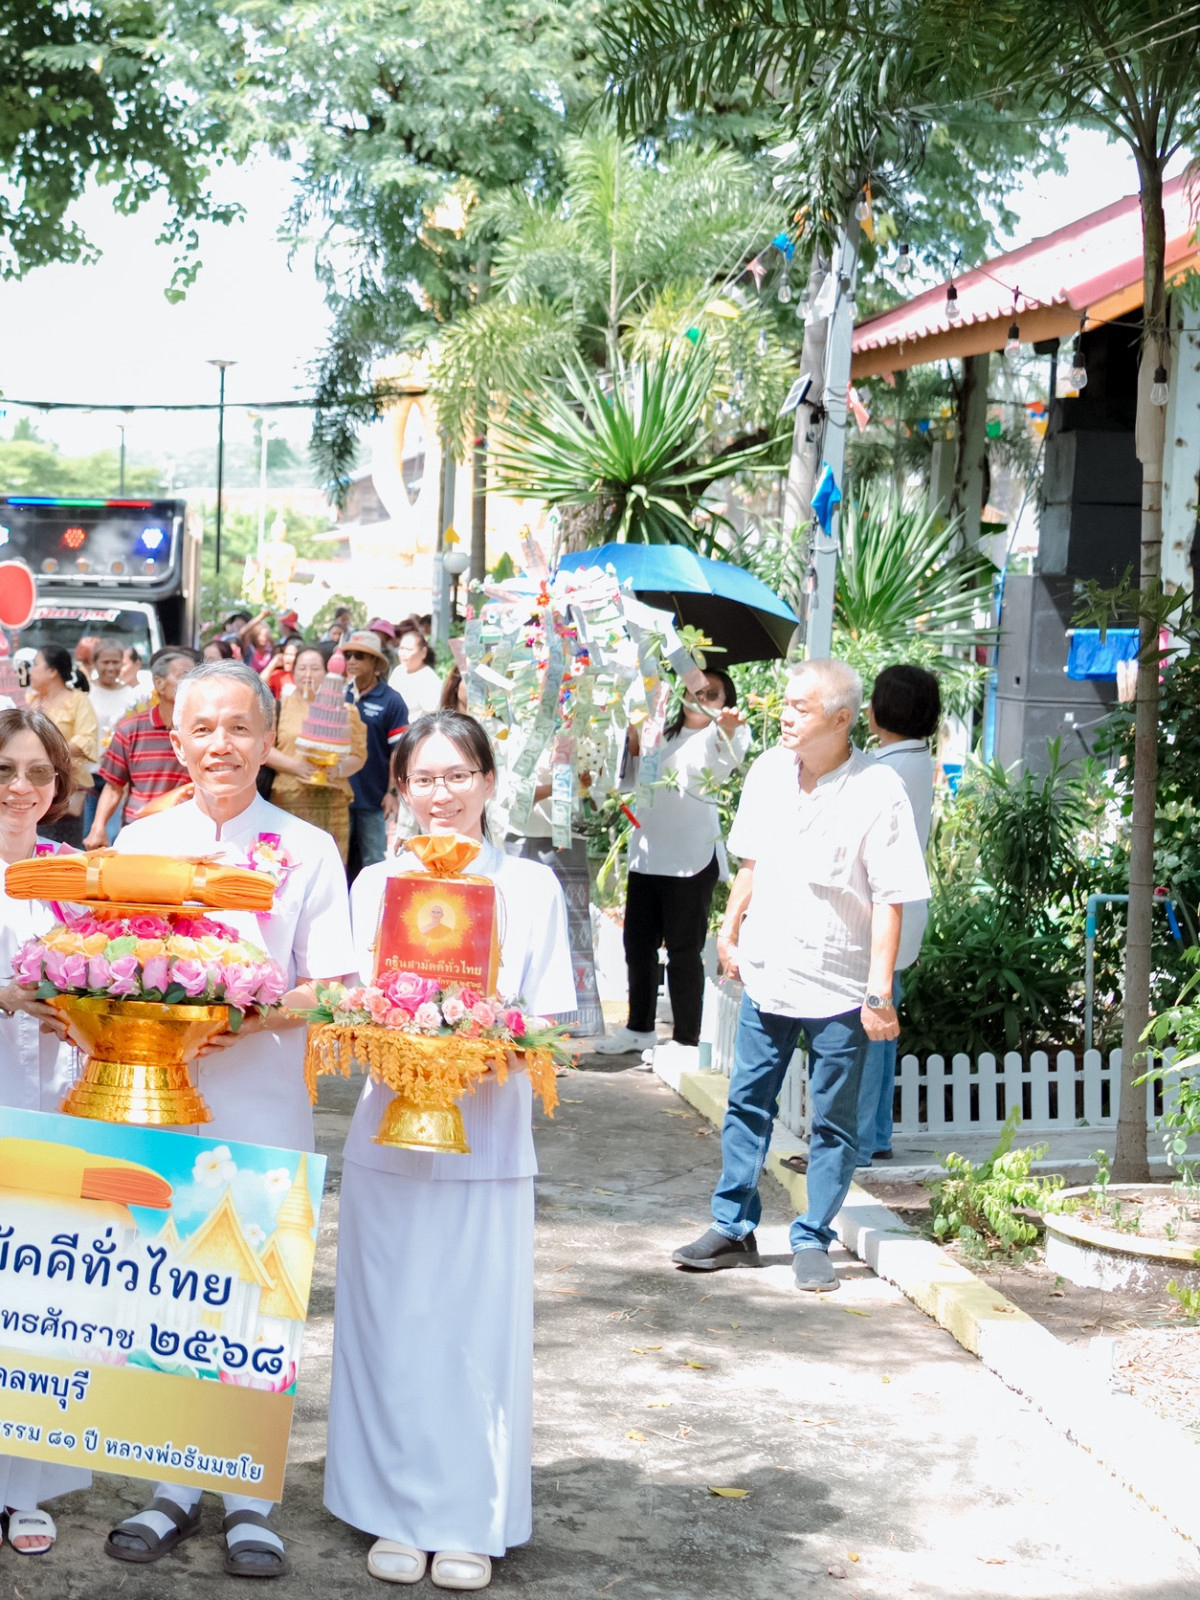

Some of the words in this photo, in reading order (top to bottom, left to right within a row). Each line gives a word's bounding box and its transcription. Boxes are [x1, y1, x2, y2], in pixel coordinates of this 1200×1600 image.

[149, 1322, 285, 1375] ๒๕๖๘
[48, 1430, 76, 1448] ๘๑
[84, 1429, 99, 1451] ปี
[105, 1438, 263, 1480] หลวงพ่อธัมมชโย
